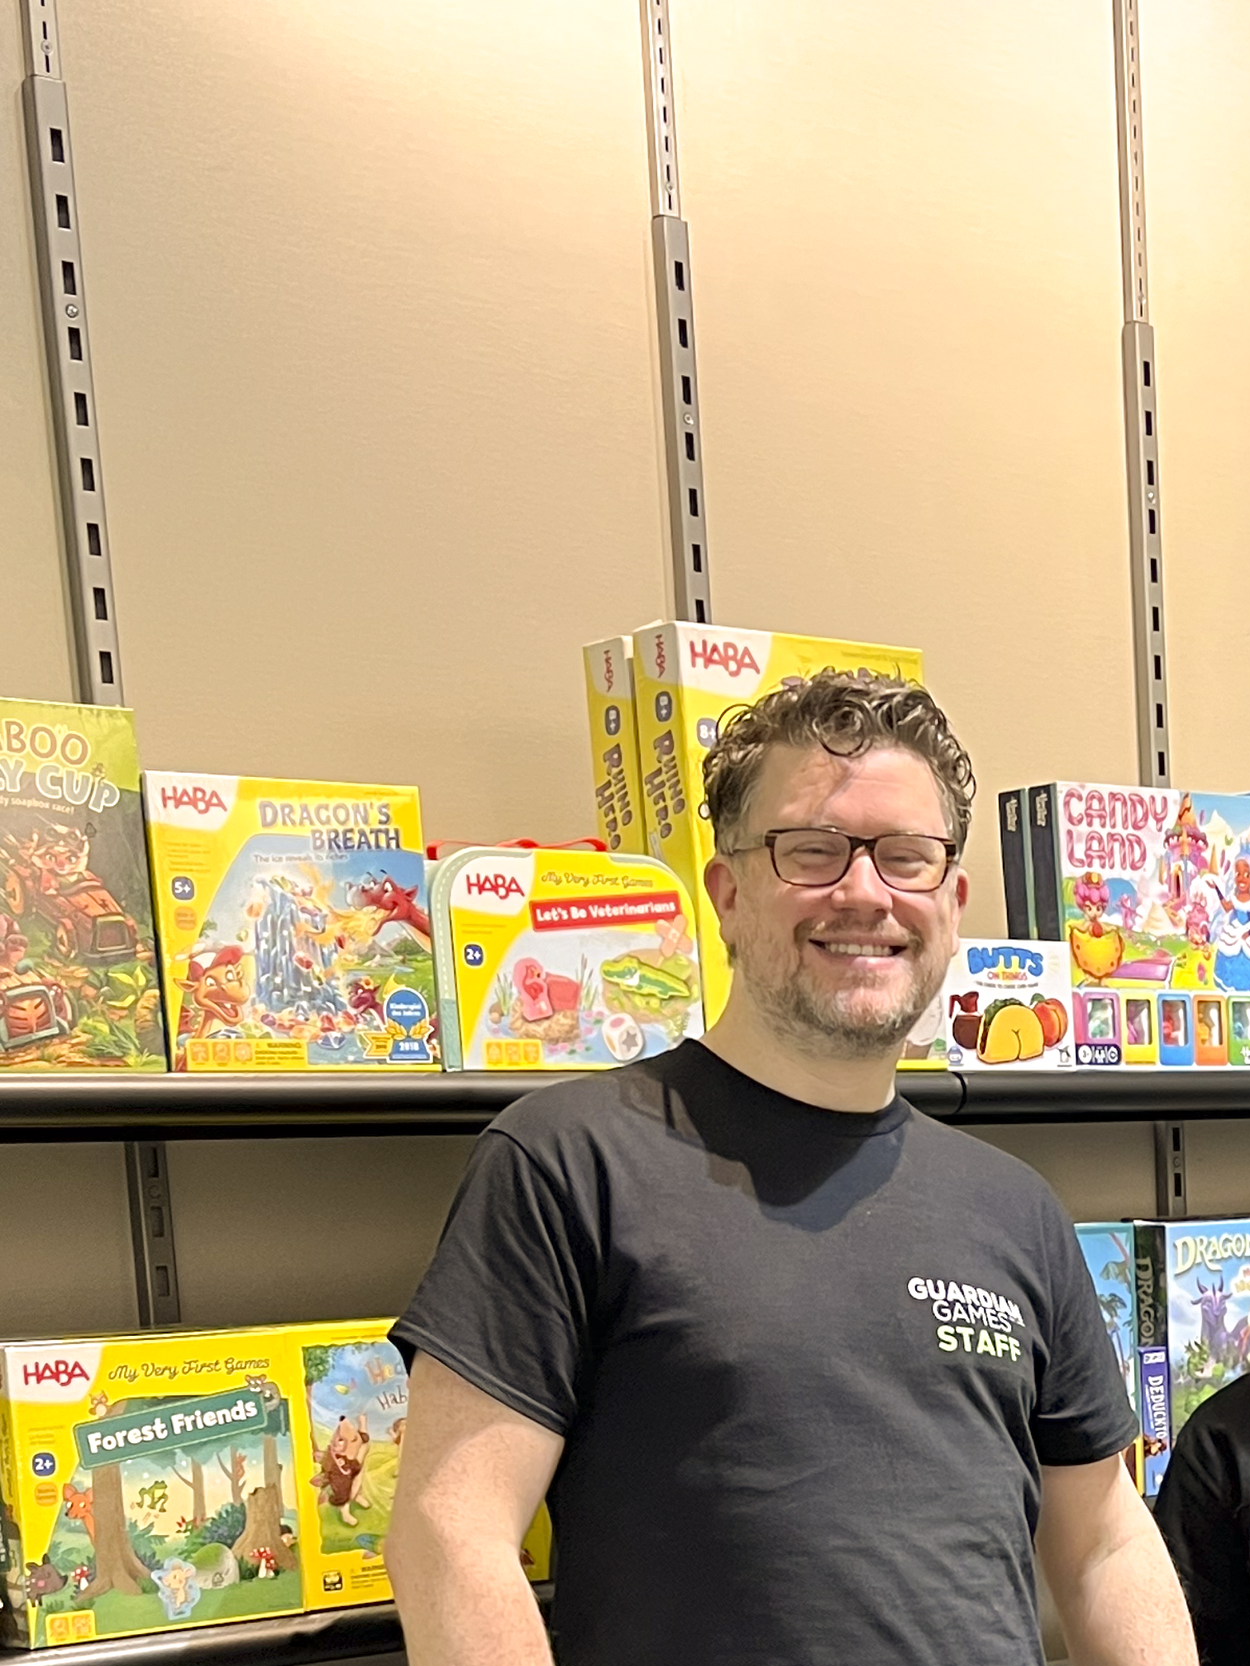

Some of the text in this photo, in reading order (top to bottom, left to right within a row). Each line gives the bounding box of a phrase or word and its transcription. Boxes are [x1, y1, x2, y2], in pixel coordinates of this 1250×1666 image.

[690, 639, 760, 677] HABA
[36, 762, 121, 814] CUP
[161, 786, 228, 815] HABA
[258, 800, 392, 828] DRAGON'S
[1063, 787, 1168, 832] CANDY
[310, 828, 401, 852] BREATH
[1066, 829, 1147, 871] LAND
[466, 874, 526, 900] HABA
[536, 901, 676, 922] Let's Be Veterinarians
[466, 949, 482, 961] 2+
[967, 946, 1044, 977] BUTTS
[907, 1276, 1025, 1327] GUARDIAN
[932, 1300, 1011, 1333] GAMES
[936, 1325, 1021, 1361] STAFF
[22, 1359, 91, 1387] HABA
[108, 1357, 271, 1382] My Very First Games
[87, 1422, 169, 1455] Forest
[171, 1400, 259, 1436] Friends
[34, 1458, 54, 1471] 2+
